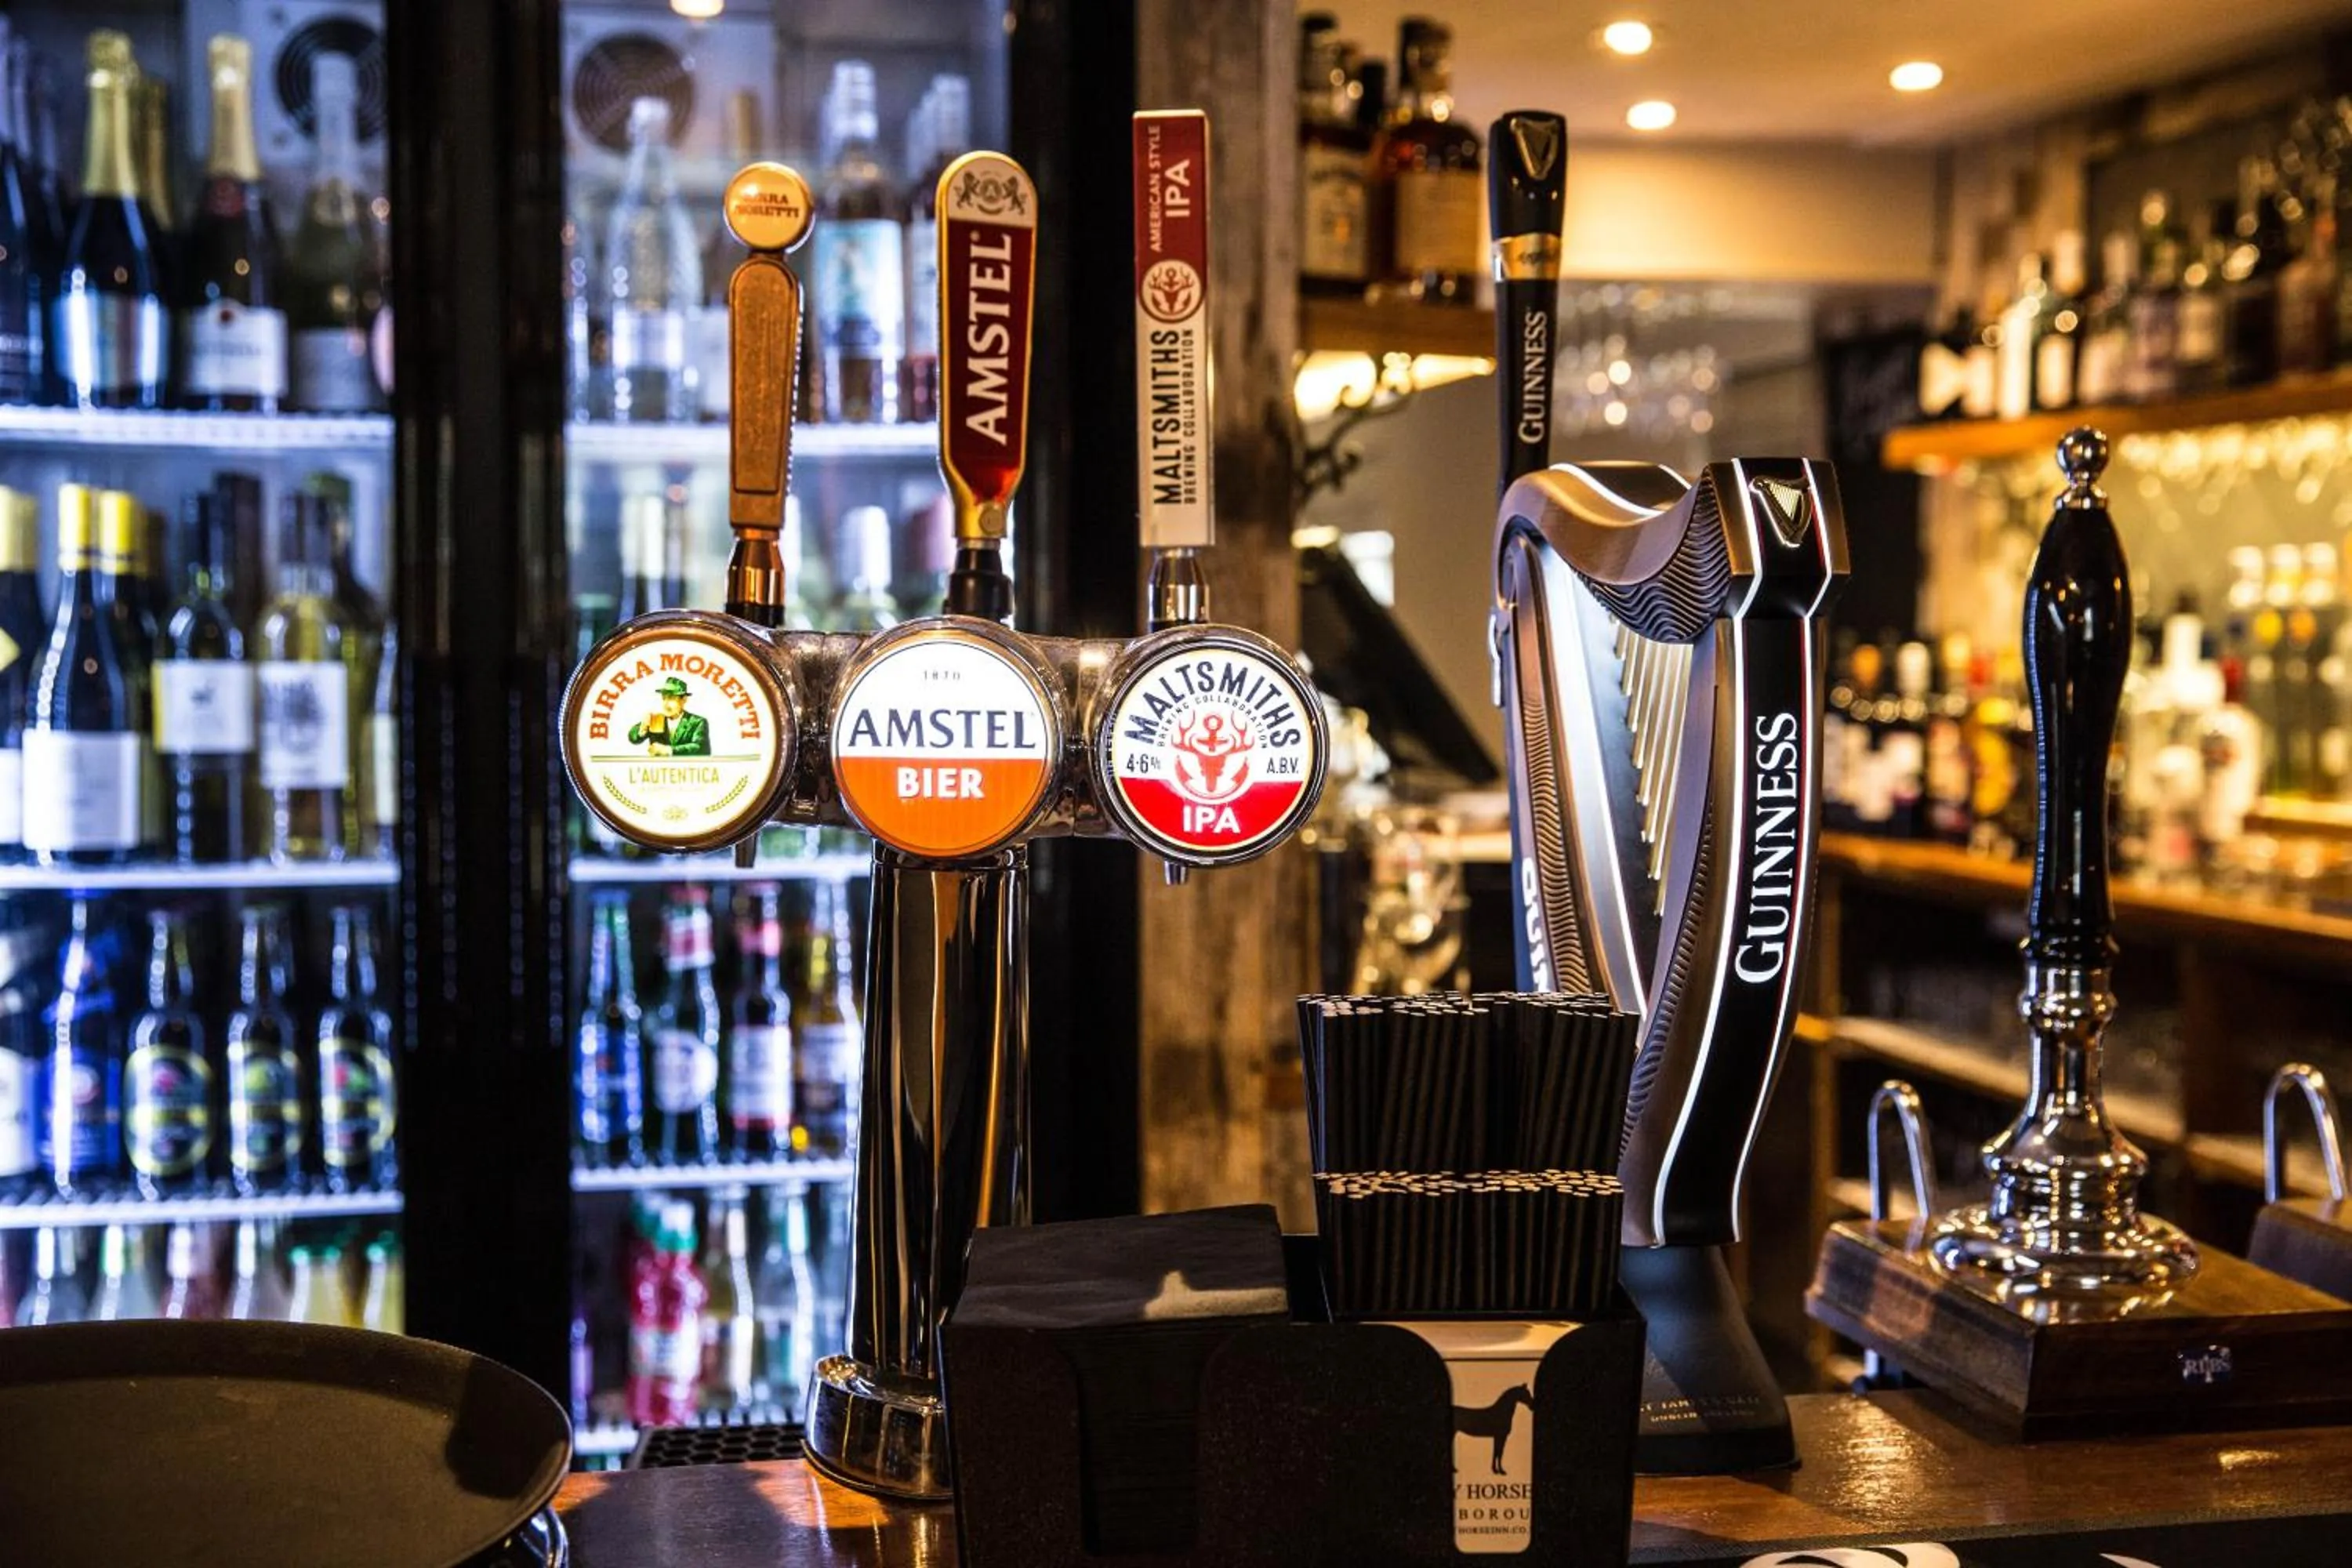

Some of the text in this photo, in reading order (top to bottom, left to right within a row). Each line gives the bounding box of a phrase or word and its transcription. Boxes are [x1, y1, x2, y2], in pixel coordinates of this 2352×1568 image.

[1149, 125, 1162, 252] AMERICAN STYLE
[1165, 159, 1190, 217] IPA
[966, 234, 1011, 445] AMSTEL
[1519, 310, 1547, 445] GUINNESS
[1150, 329, 1181, 504] MALTSMITHS
[1181, 329, 1196, 504] BREWING COLLABORATION
[590, 654, 760, 739] BIRRA MORETTI
[848, 709, 1036, 749] AMSTEL
[1124, 661, 1301, 748] MALTSMITHS
[1195, 695, 1267, 749] COLLABORATION
[629, 767, 720, 785] L'AUTENTICA
[897, 766, 985, 799] BIER
[1183, 804, 1240, 833] IPA
[1734, 711, 1798, 984] GUINNESS
